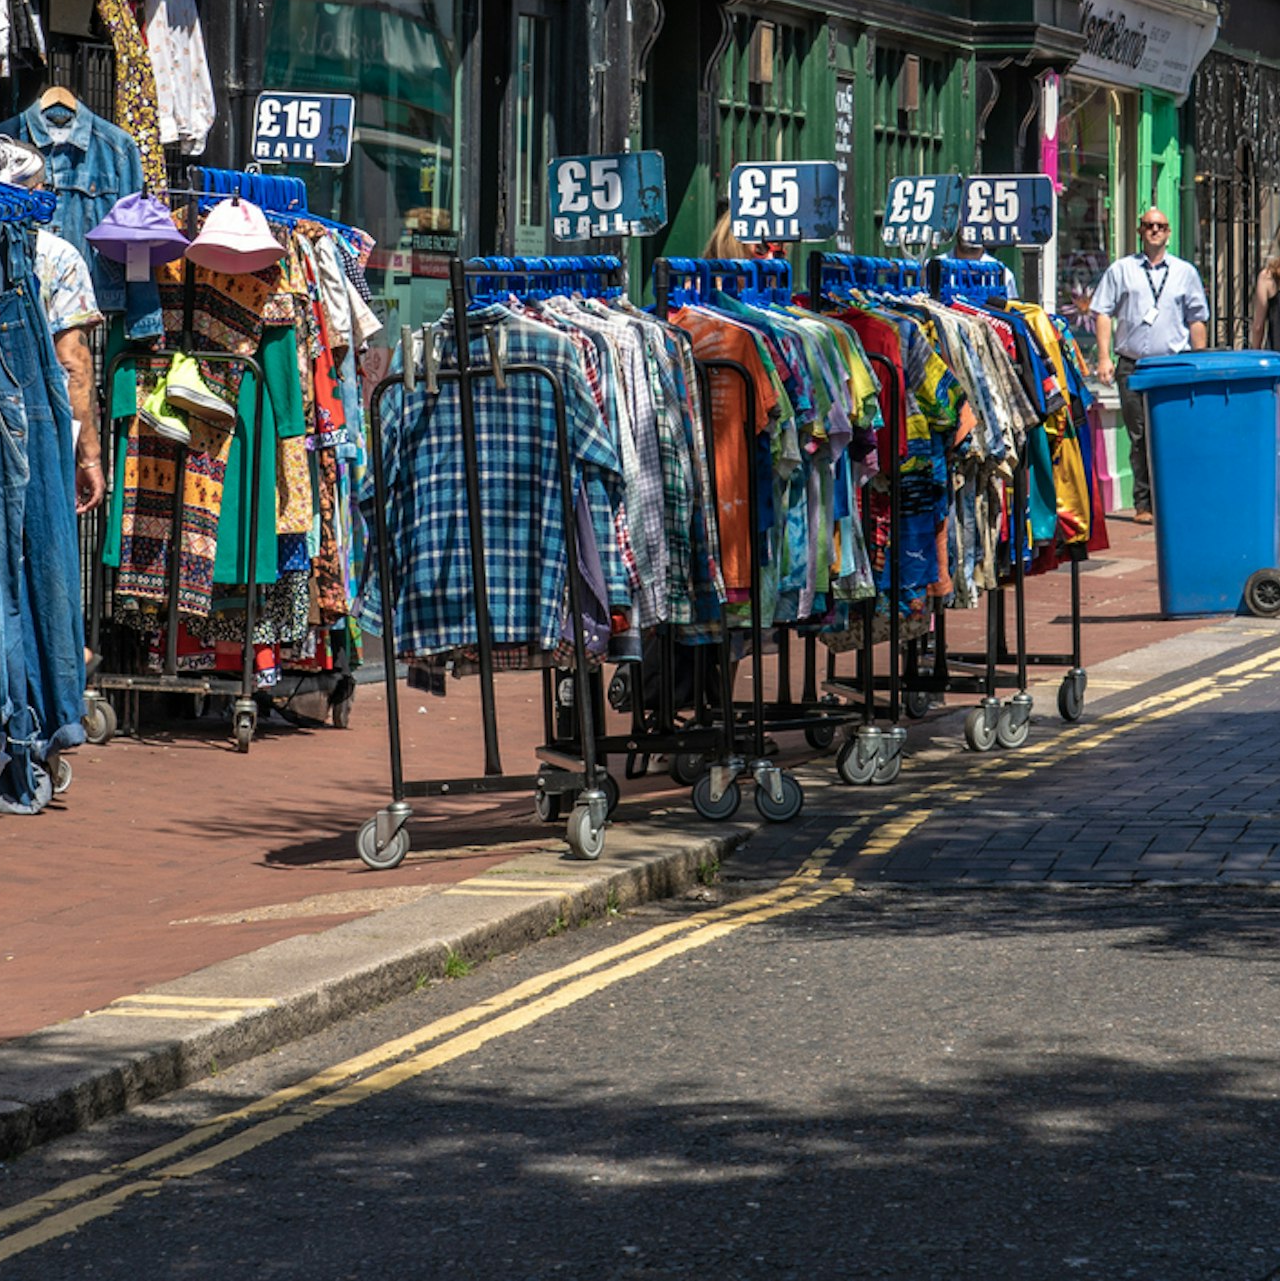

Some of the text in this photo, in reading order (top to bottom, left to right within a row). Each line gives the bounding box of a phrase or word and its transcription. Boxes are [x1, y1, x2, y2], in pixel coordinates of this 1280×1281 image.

[256, 98, 322, 140] £15
[255, 140, 316, 159] RAIL
[556, 157, 624, 214] £5
[738, 167, 800, 217] £5
[888, 178, 937, 223] £5
[966, 179, 1019, 223] £5
[733, 218, 802, 238] RAIL
[962, 224, 1022, 242] RAIL
